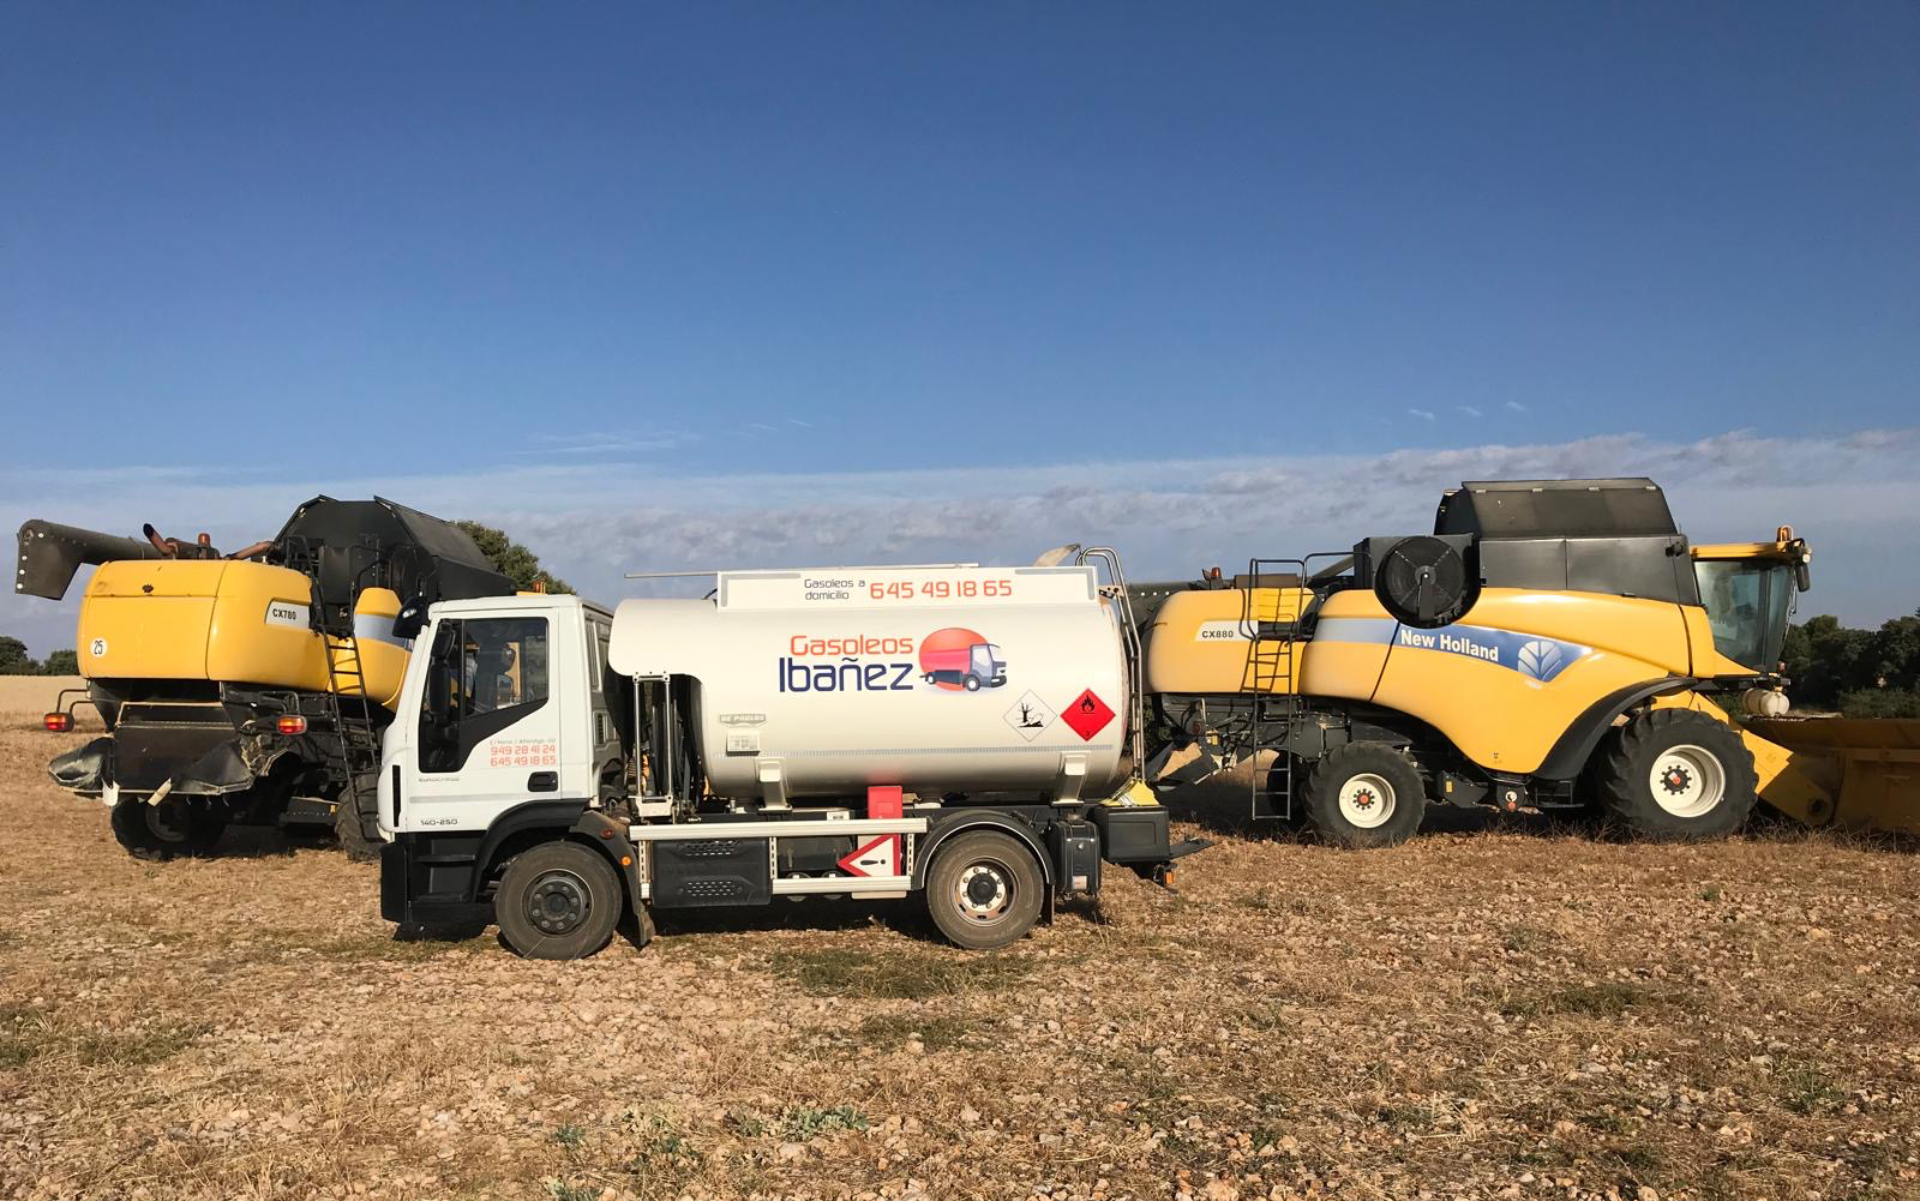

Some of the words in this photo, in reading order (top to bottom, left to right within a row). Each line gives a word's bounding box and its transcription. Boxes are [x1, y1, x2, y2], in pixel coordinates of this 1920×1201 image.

[804, 578, 854, 589] Gasoleos
[858, 579, 866, 588] a
[870, 582, 914, 599] 645
[921, 581, 950, 599] 49
[957, 580, 977, 598] 18
[983, 579, 1013, 597] 65
[805, 590, 850, 601] domicilio
[272, 608, 297, 621] CX780
[1201, 630, 1235, 639] CX880
[93, 639, 104, 655] 25
[790, 634, 914, 656] Gasoleos
[1400, 629, 1436, 648] New
[1439, 633, 1499, 662] Holland
[779, 657, 914, 693] Ibañez
[490, 746, 512, 756] 949
[514, 745, 529, 755] 28
[531, 744, 540, 754] 41
[542, 744, 556, 754] 24
[490, 757, 512, 767] 645
[514, 756, 528, 766] 49
[530, 755, 540, 765] 18
[542, 755, 557, 765] 65
